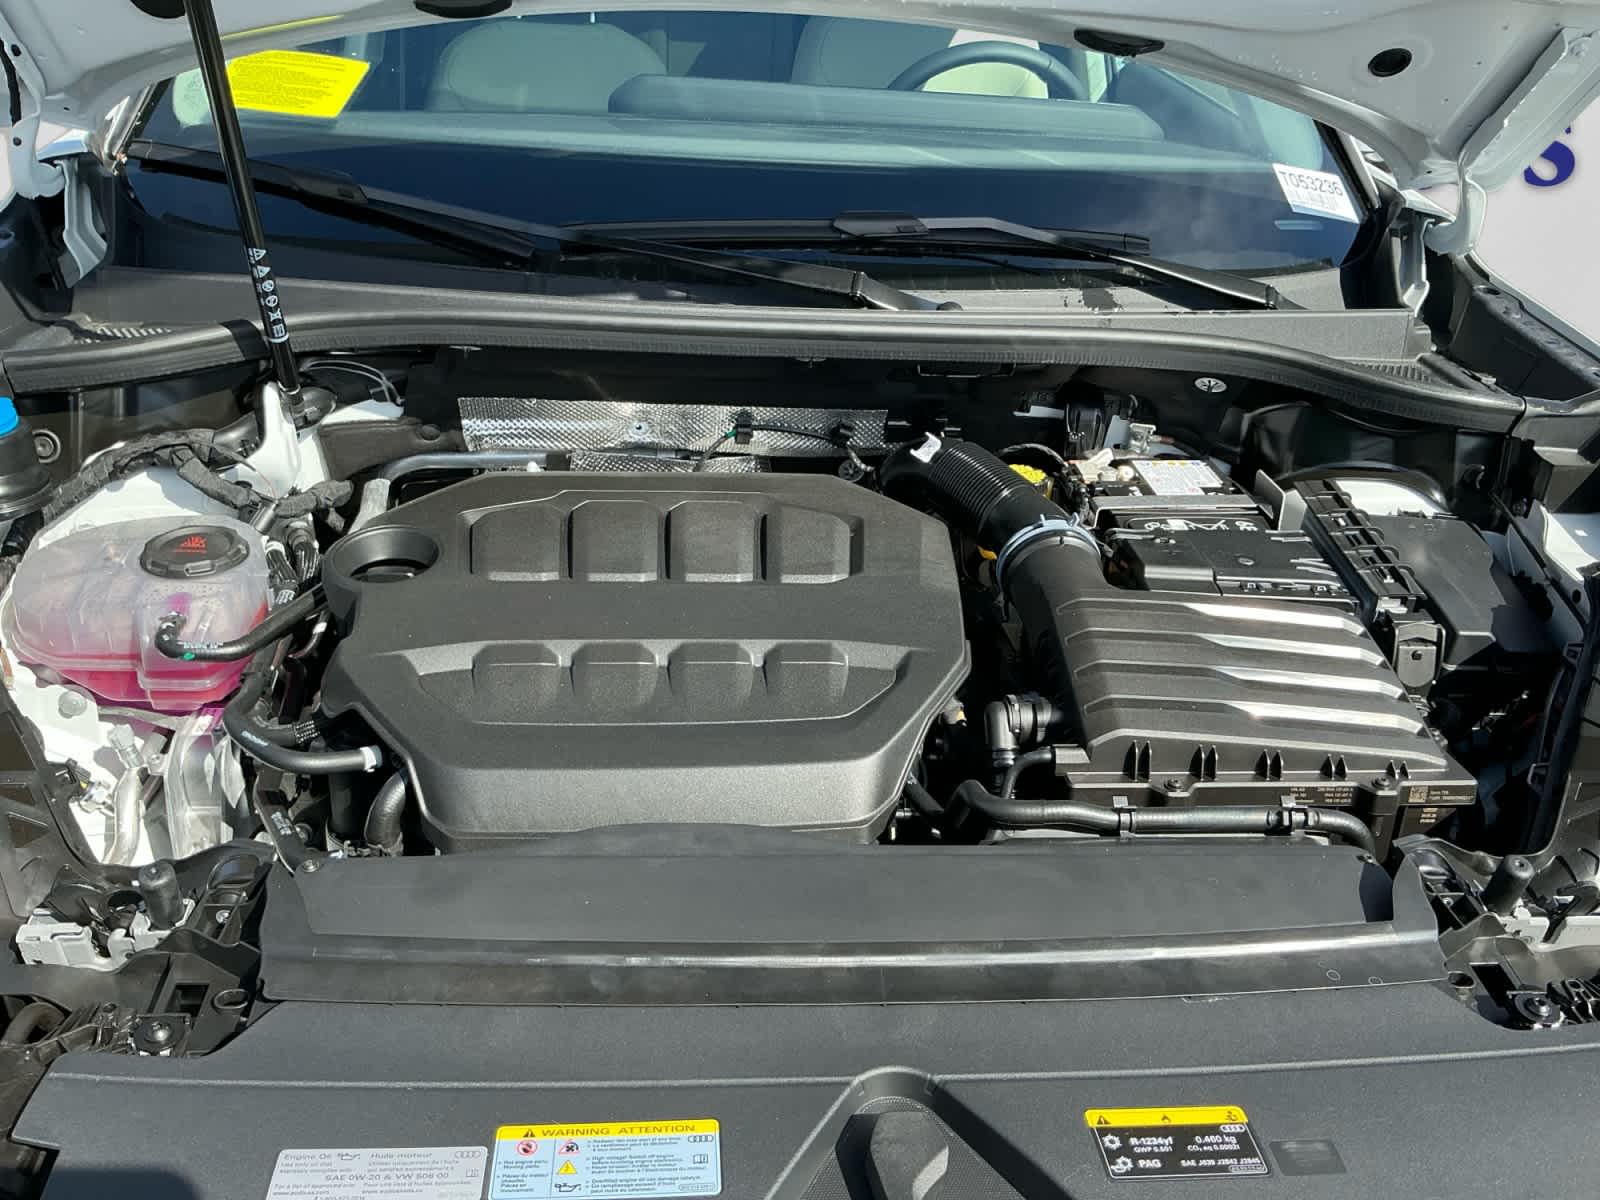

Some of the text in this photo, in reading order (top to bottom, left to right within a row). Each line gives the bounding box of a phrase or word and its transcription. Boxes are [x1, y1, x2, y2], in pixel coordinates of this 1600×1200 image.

[1278, 170, 1344, 196] T053236
[541, 1125, 696, 1137] WARNING ATTENTION
[1137, 1159, 1162, 1169] PAG
